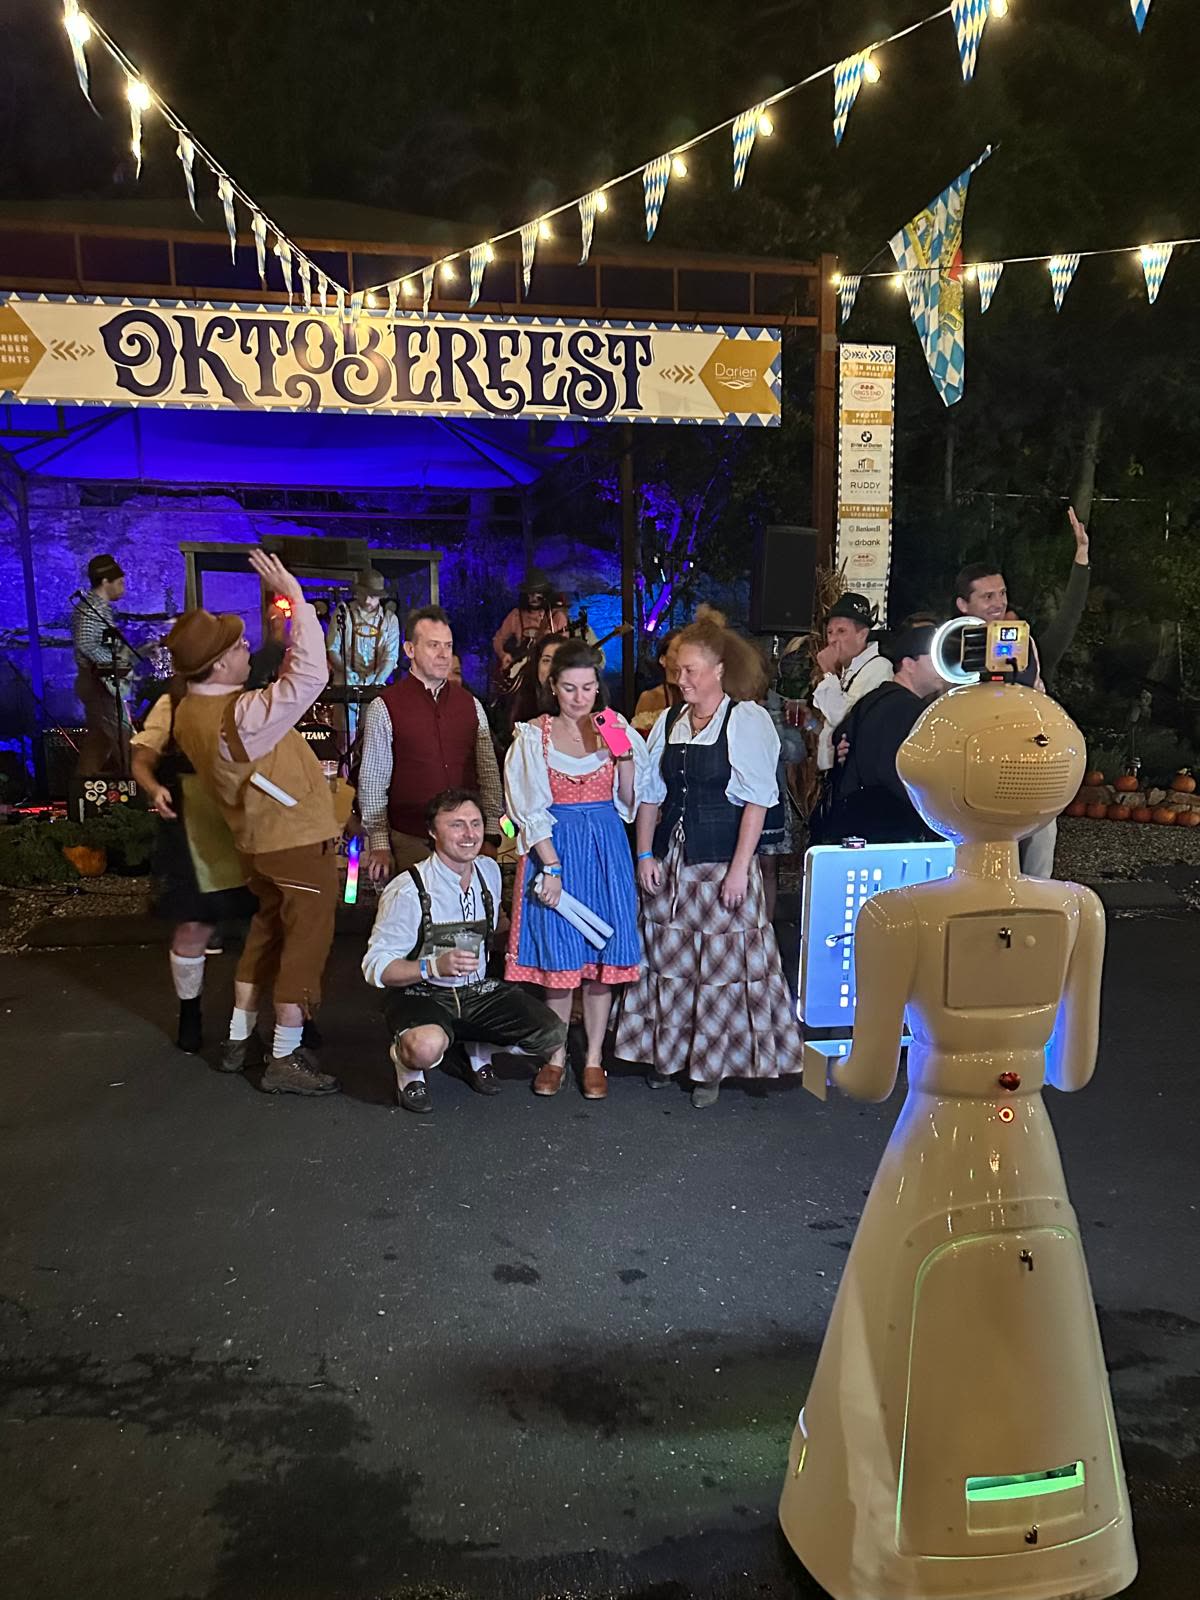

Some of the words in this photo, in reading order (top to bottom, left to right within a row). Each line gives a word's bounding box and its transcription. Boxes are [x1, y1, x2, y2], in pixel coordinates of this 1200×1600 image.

[99, 308, 653, 417] OKTOBERFEST
[715, 362, 757, 377] Darien
[850, 481, 881, 489] RUDDY
